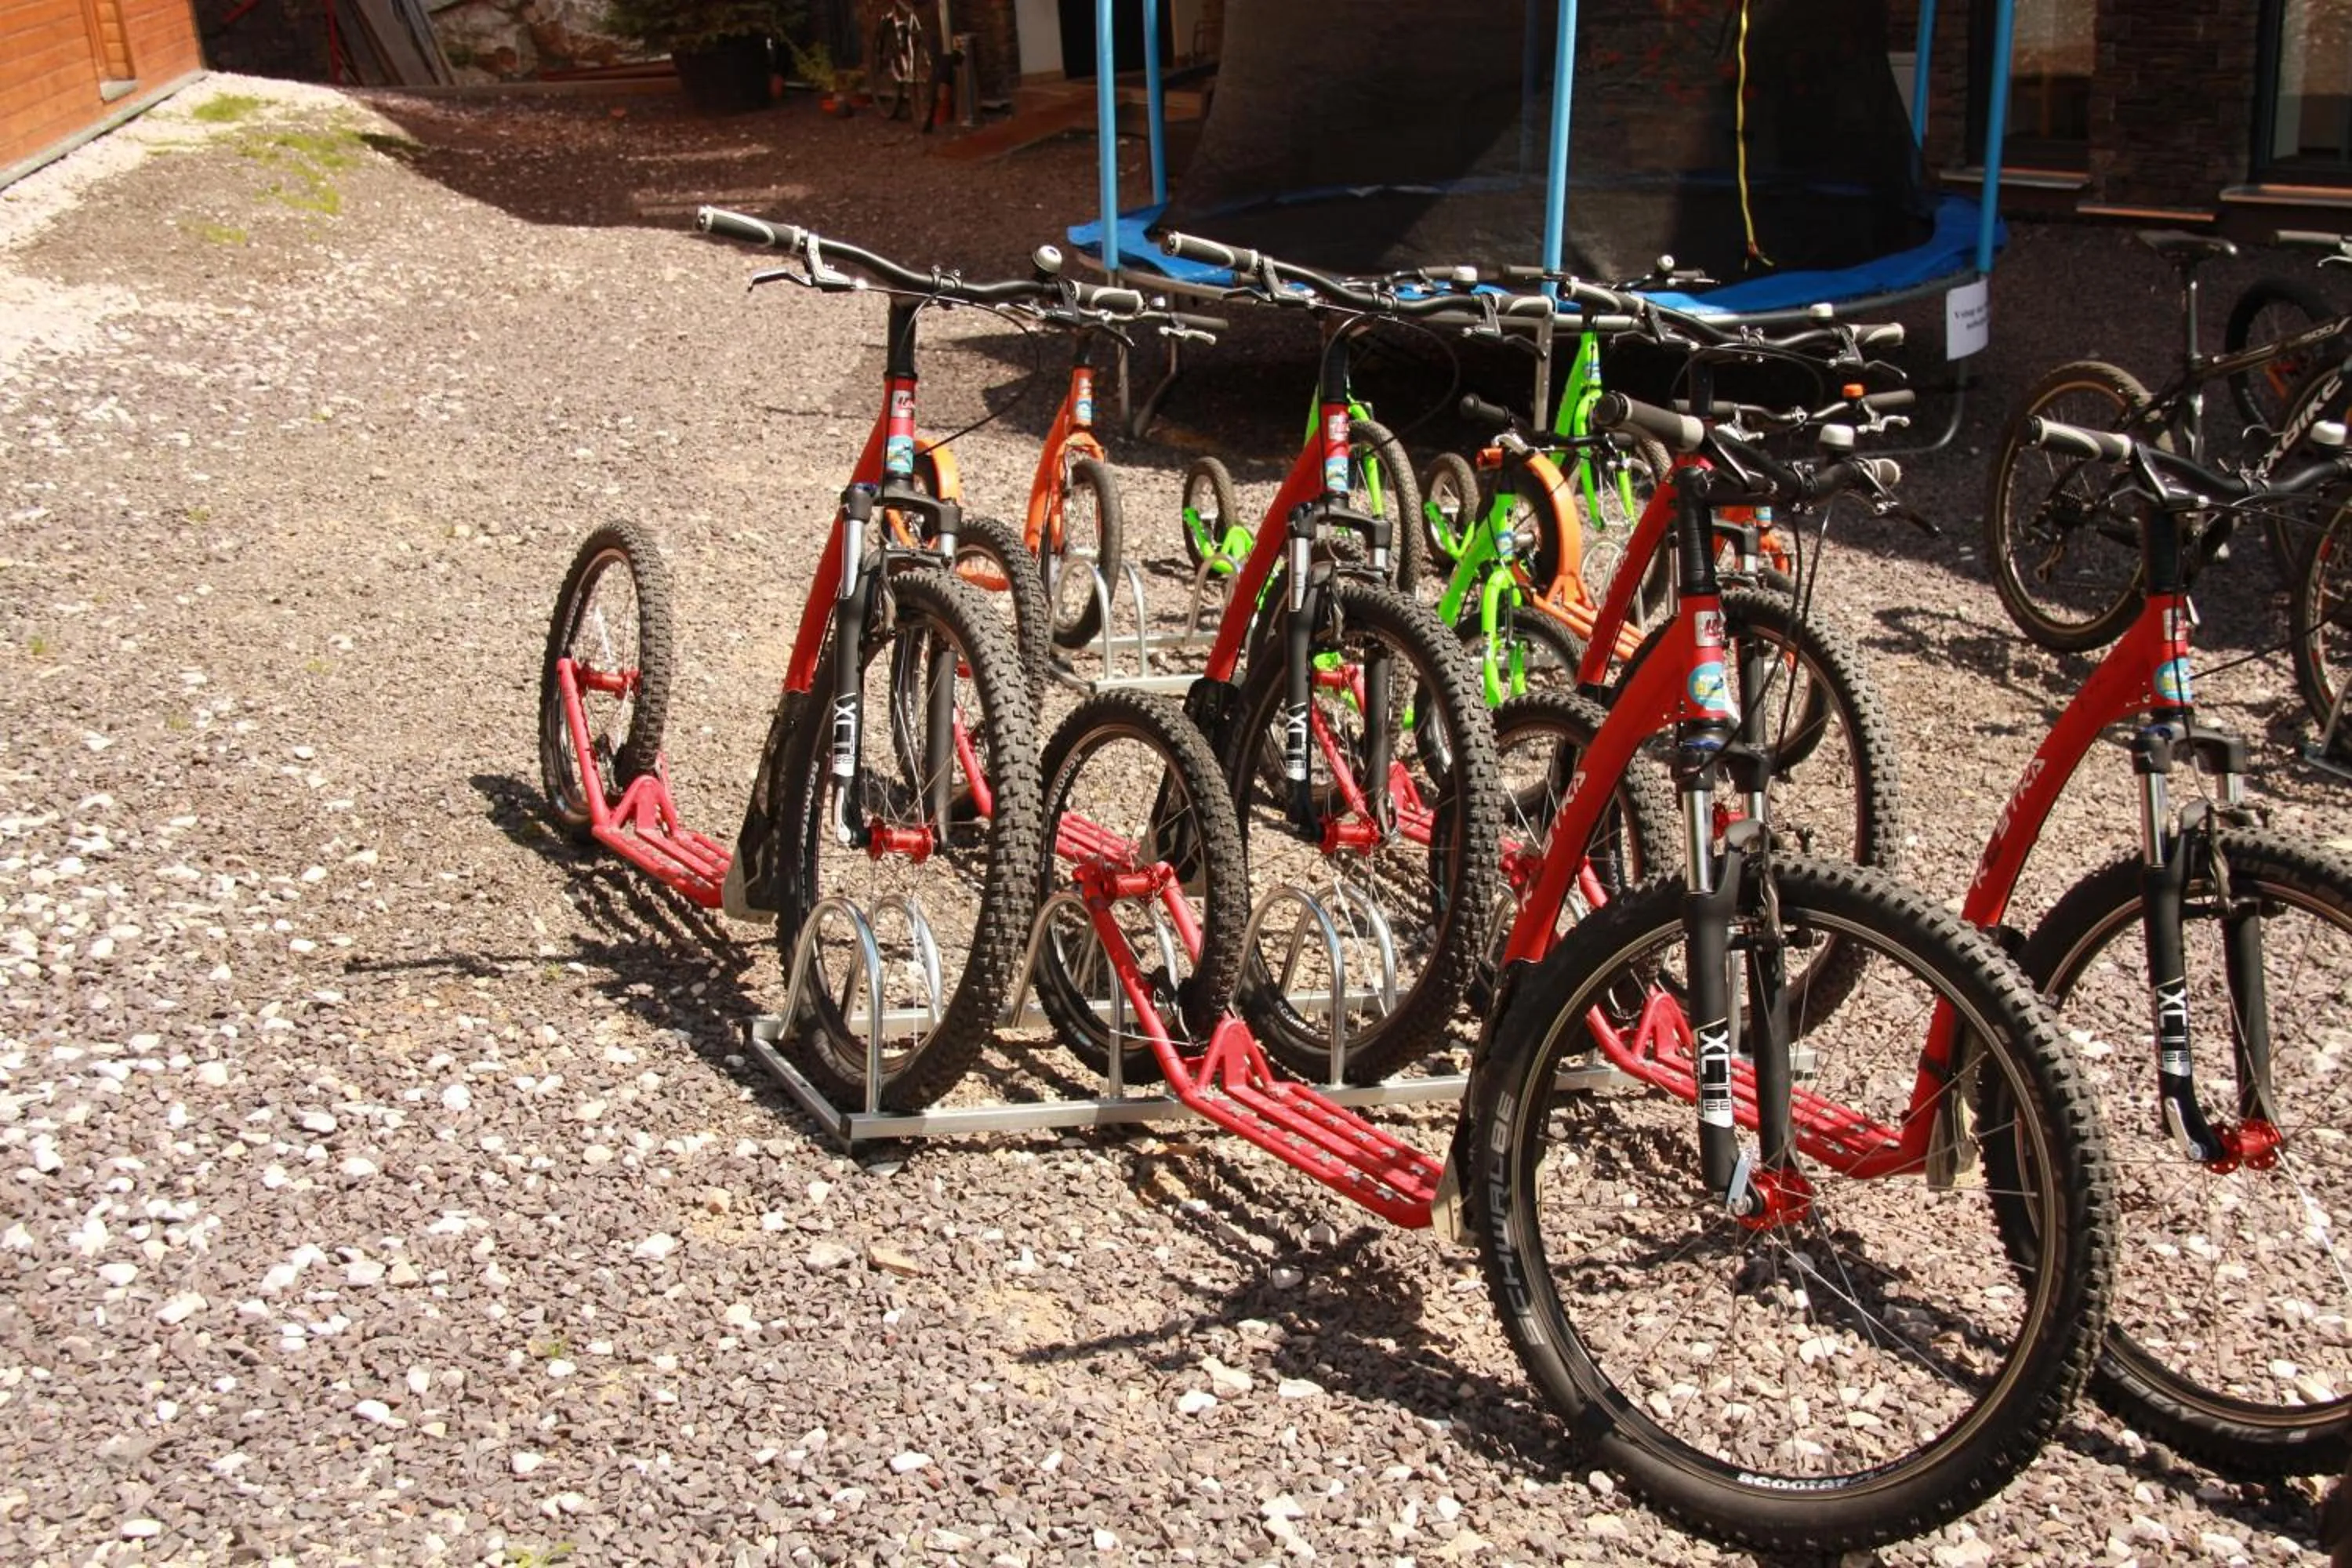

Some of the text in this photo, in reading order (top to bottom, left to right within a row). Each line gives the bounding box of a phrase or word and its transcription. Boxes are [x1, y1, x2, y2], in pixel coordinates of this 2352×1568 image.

[2158, 989, 2188, 1050] XCT
[1700, 1029, 1731, 1098] XCT
[1489, 1090, 1544, 1346] SCHWALBE
